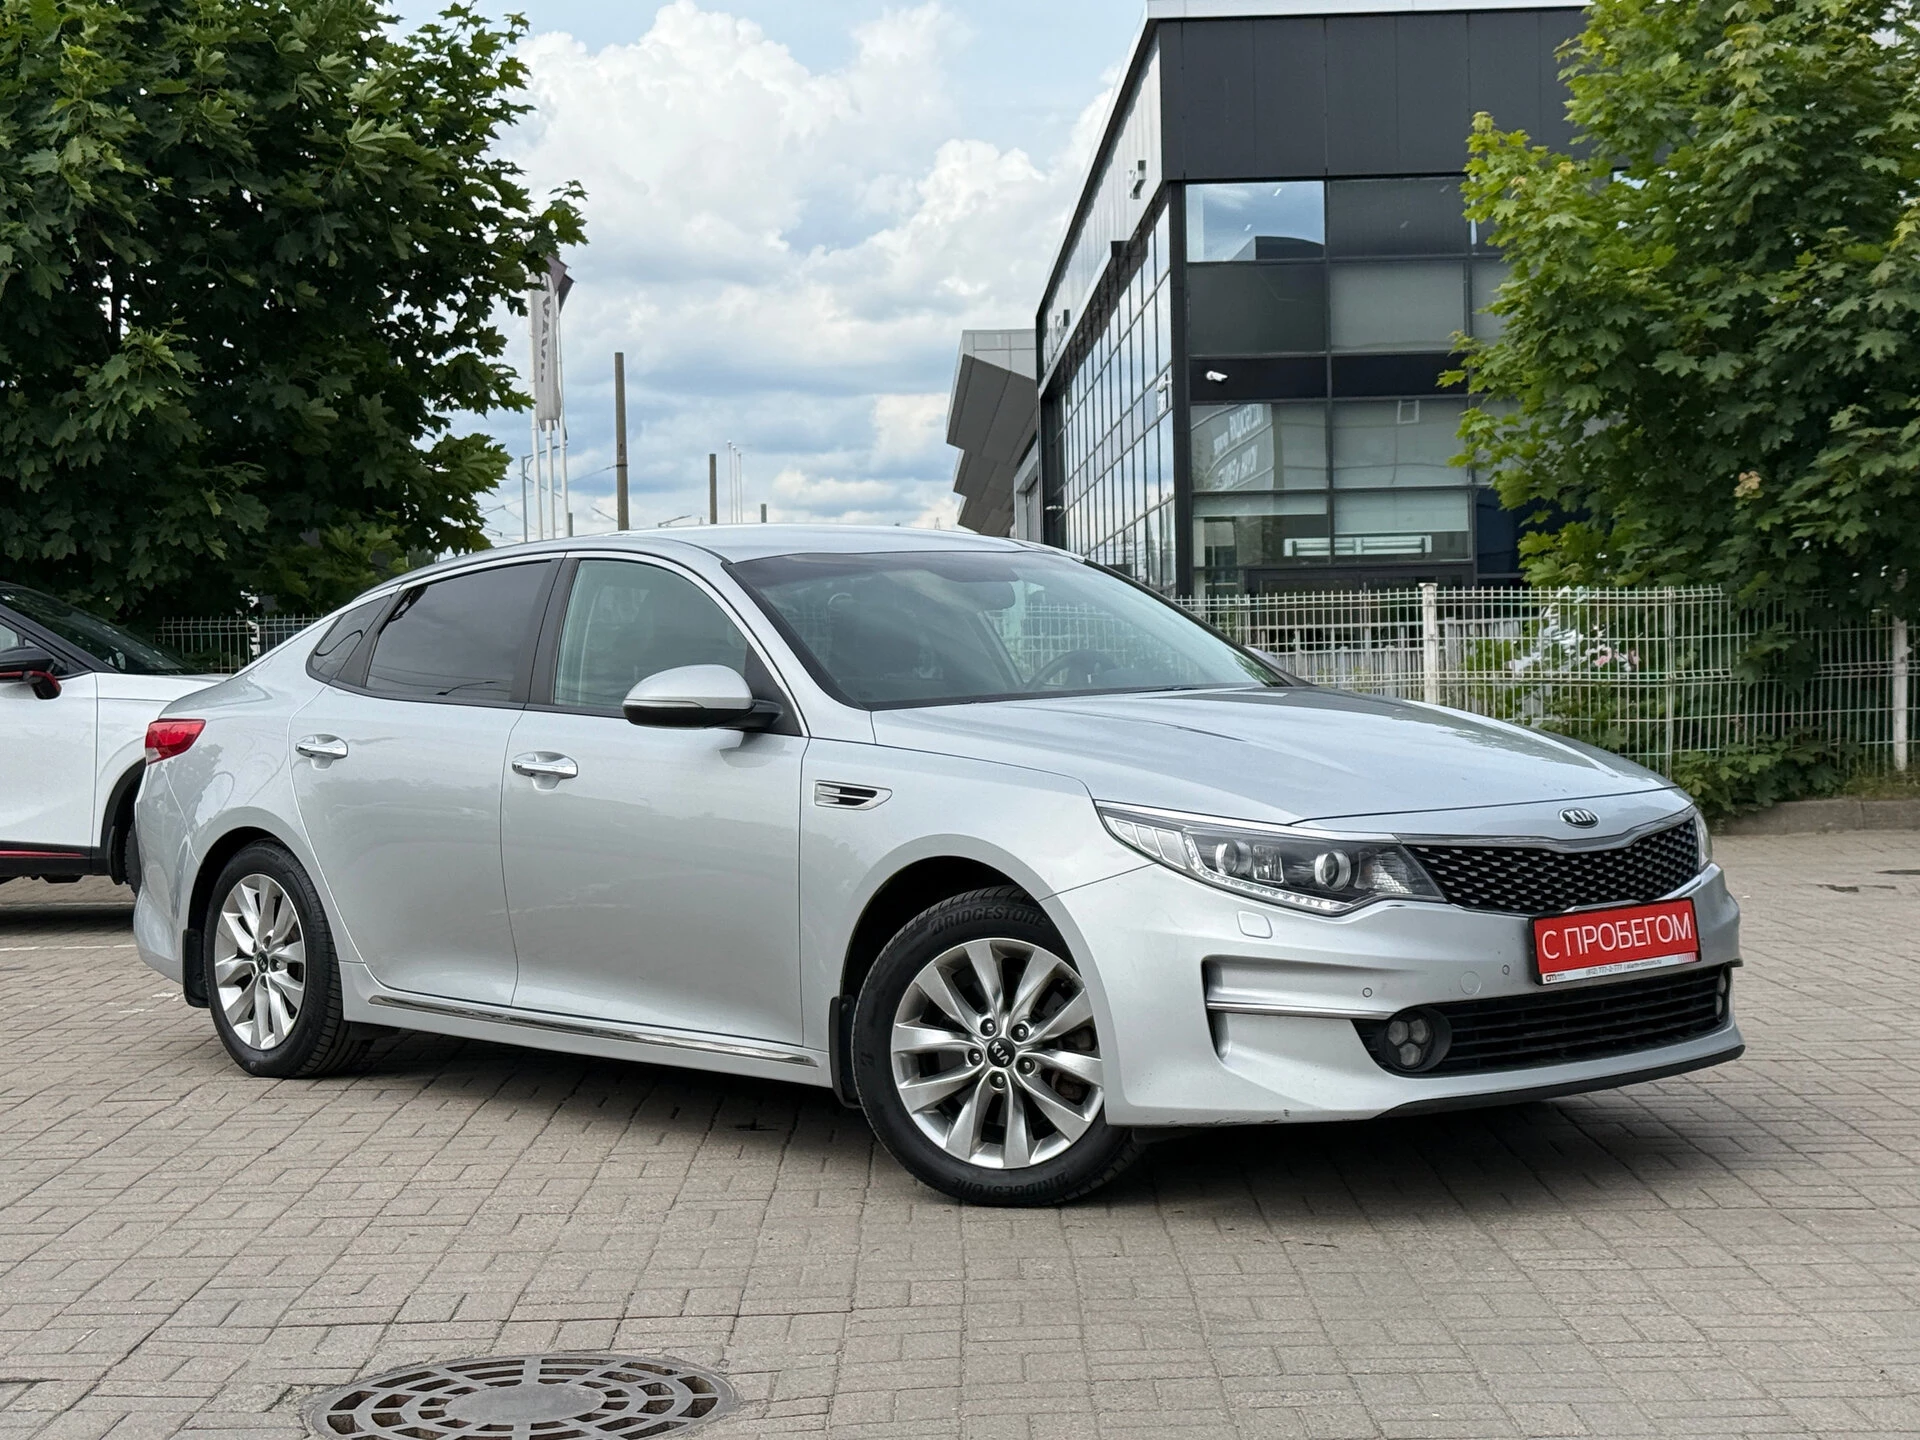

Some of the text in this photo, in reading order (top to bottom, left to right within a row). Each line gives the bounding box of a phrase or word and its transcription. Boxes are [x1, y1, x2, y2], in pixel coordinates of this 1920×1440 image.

[1563, 810, 1597, 823] KIA
[930, 906, 1046, 935] BRIDGESTONE
[1541, 912, 1693, 960] С ПРОБЕГОМ
[991, 1041, 1010, 1065] KIA
